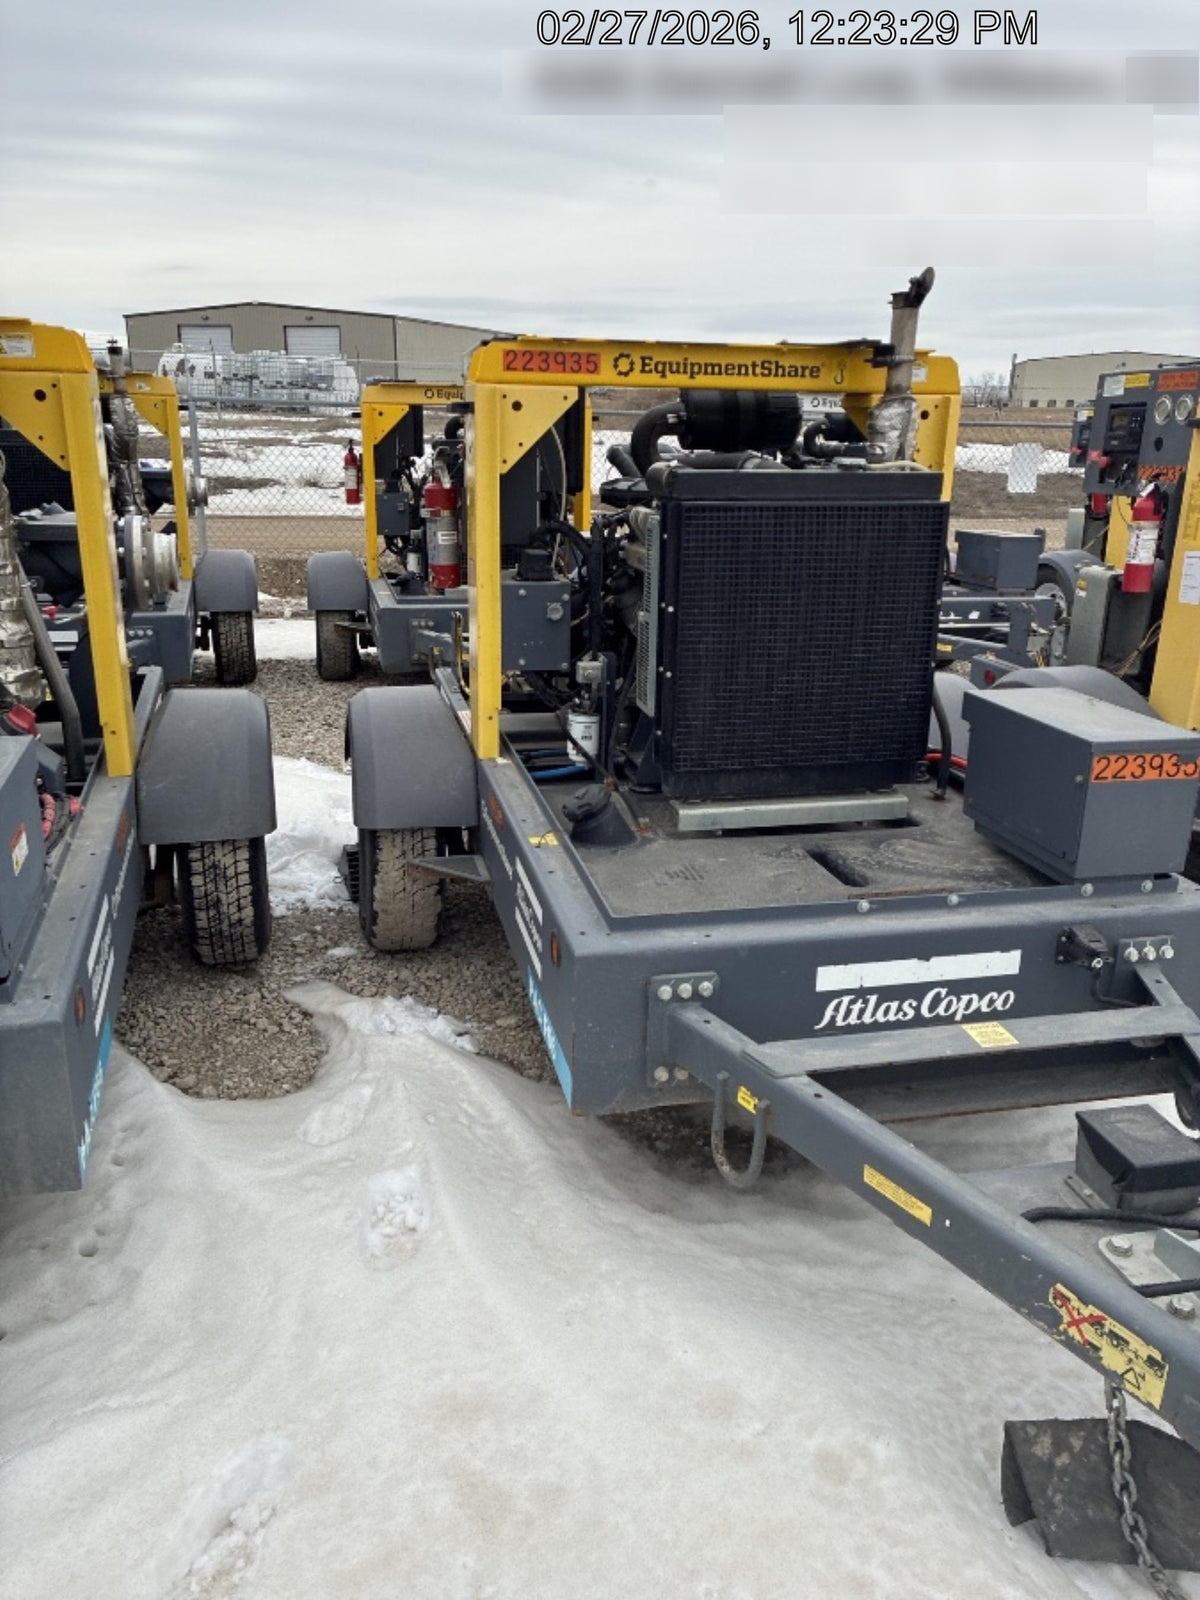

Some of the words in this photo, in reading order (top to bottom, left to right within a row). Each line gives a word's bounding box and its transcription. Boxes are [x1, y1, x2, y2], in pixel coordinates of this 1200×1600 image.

[505, 350, 598, 374] 223935
[640, 355, 821, 379] EquipmentShare
[814, 994, 918, 1030] Atlas
[920, 987, 1015, 1021] Copco
